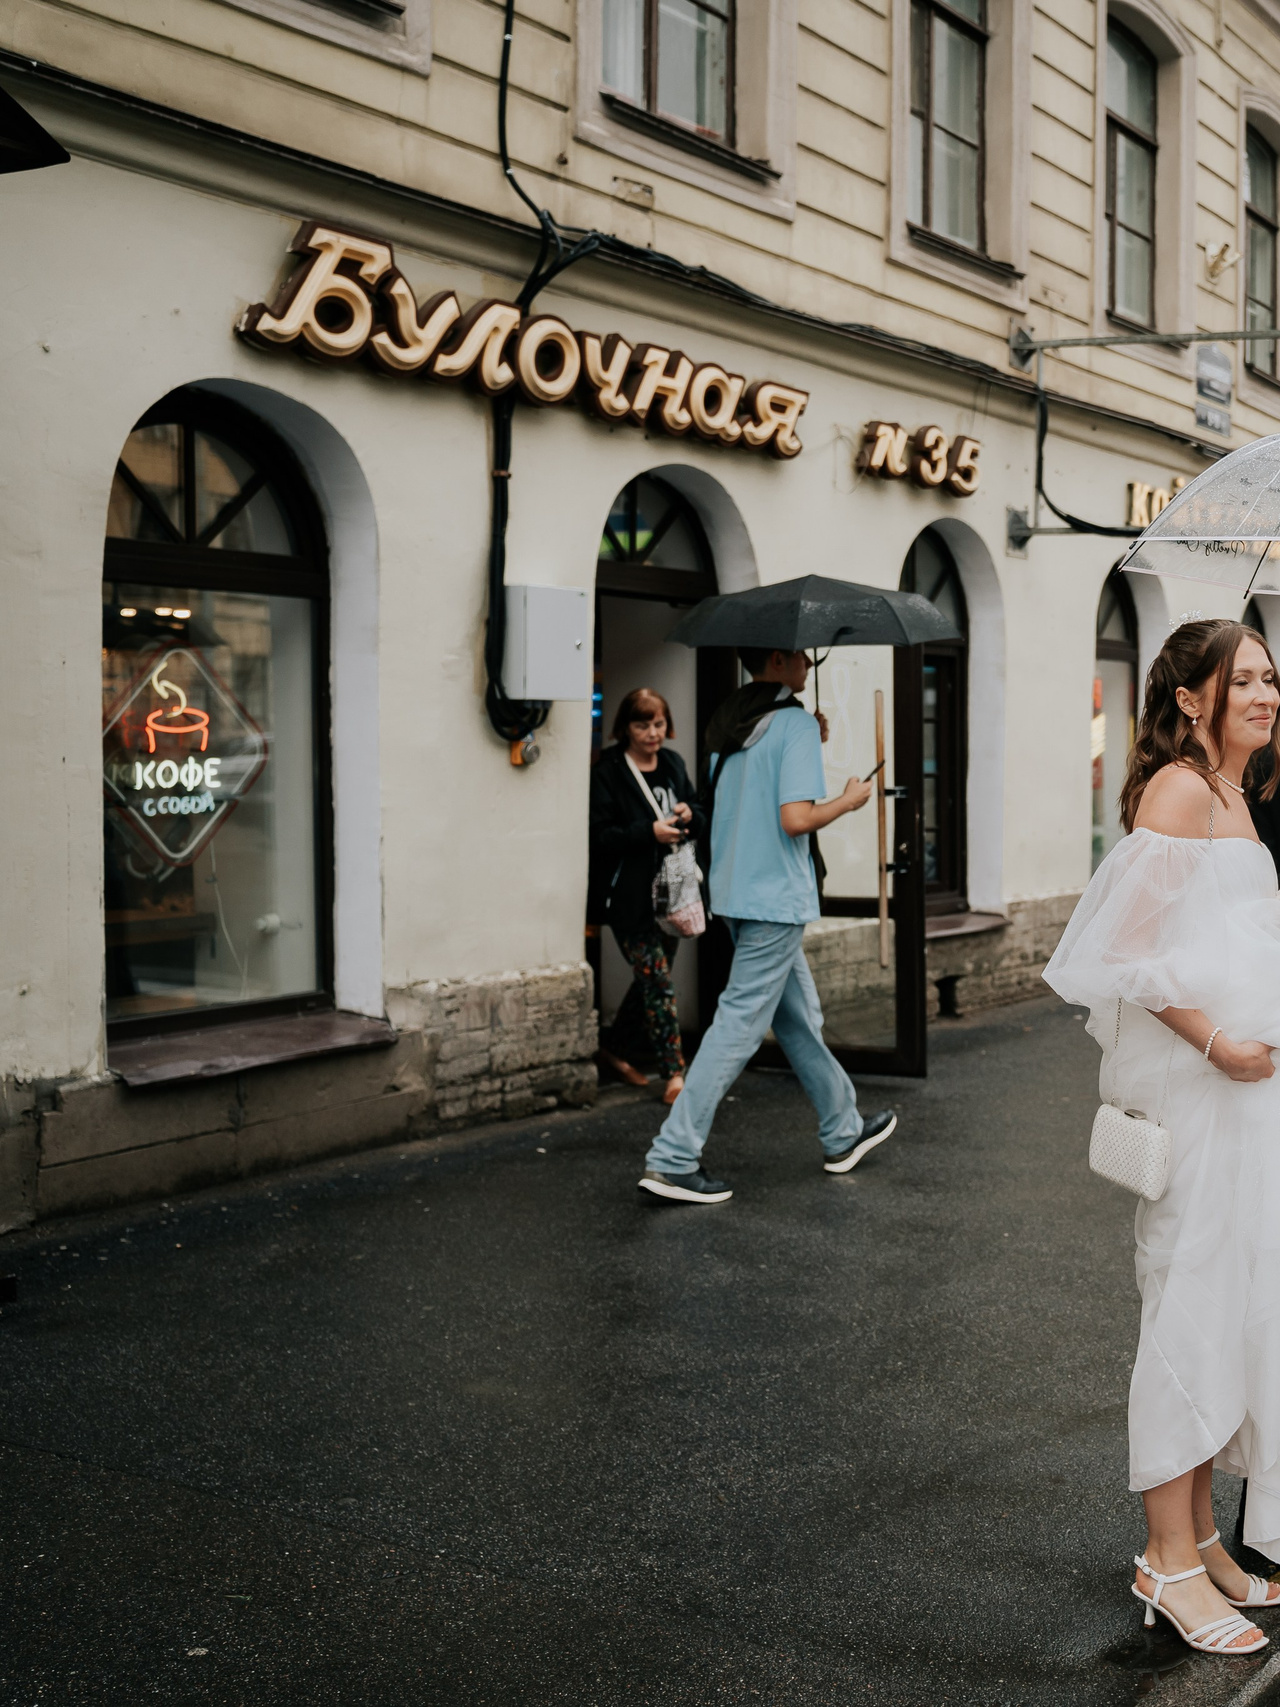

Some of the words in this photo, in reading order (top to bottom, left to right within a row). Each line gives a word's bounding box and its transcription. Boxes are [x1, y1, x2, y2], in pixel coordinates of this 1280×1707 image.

[240, 221, 809, 458] Булочная
[914, 425, 981, 495] 35
[134, 756, 221, 790] КОФЕ
